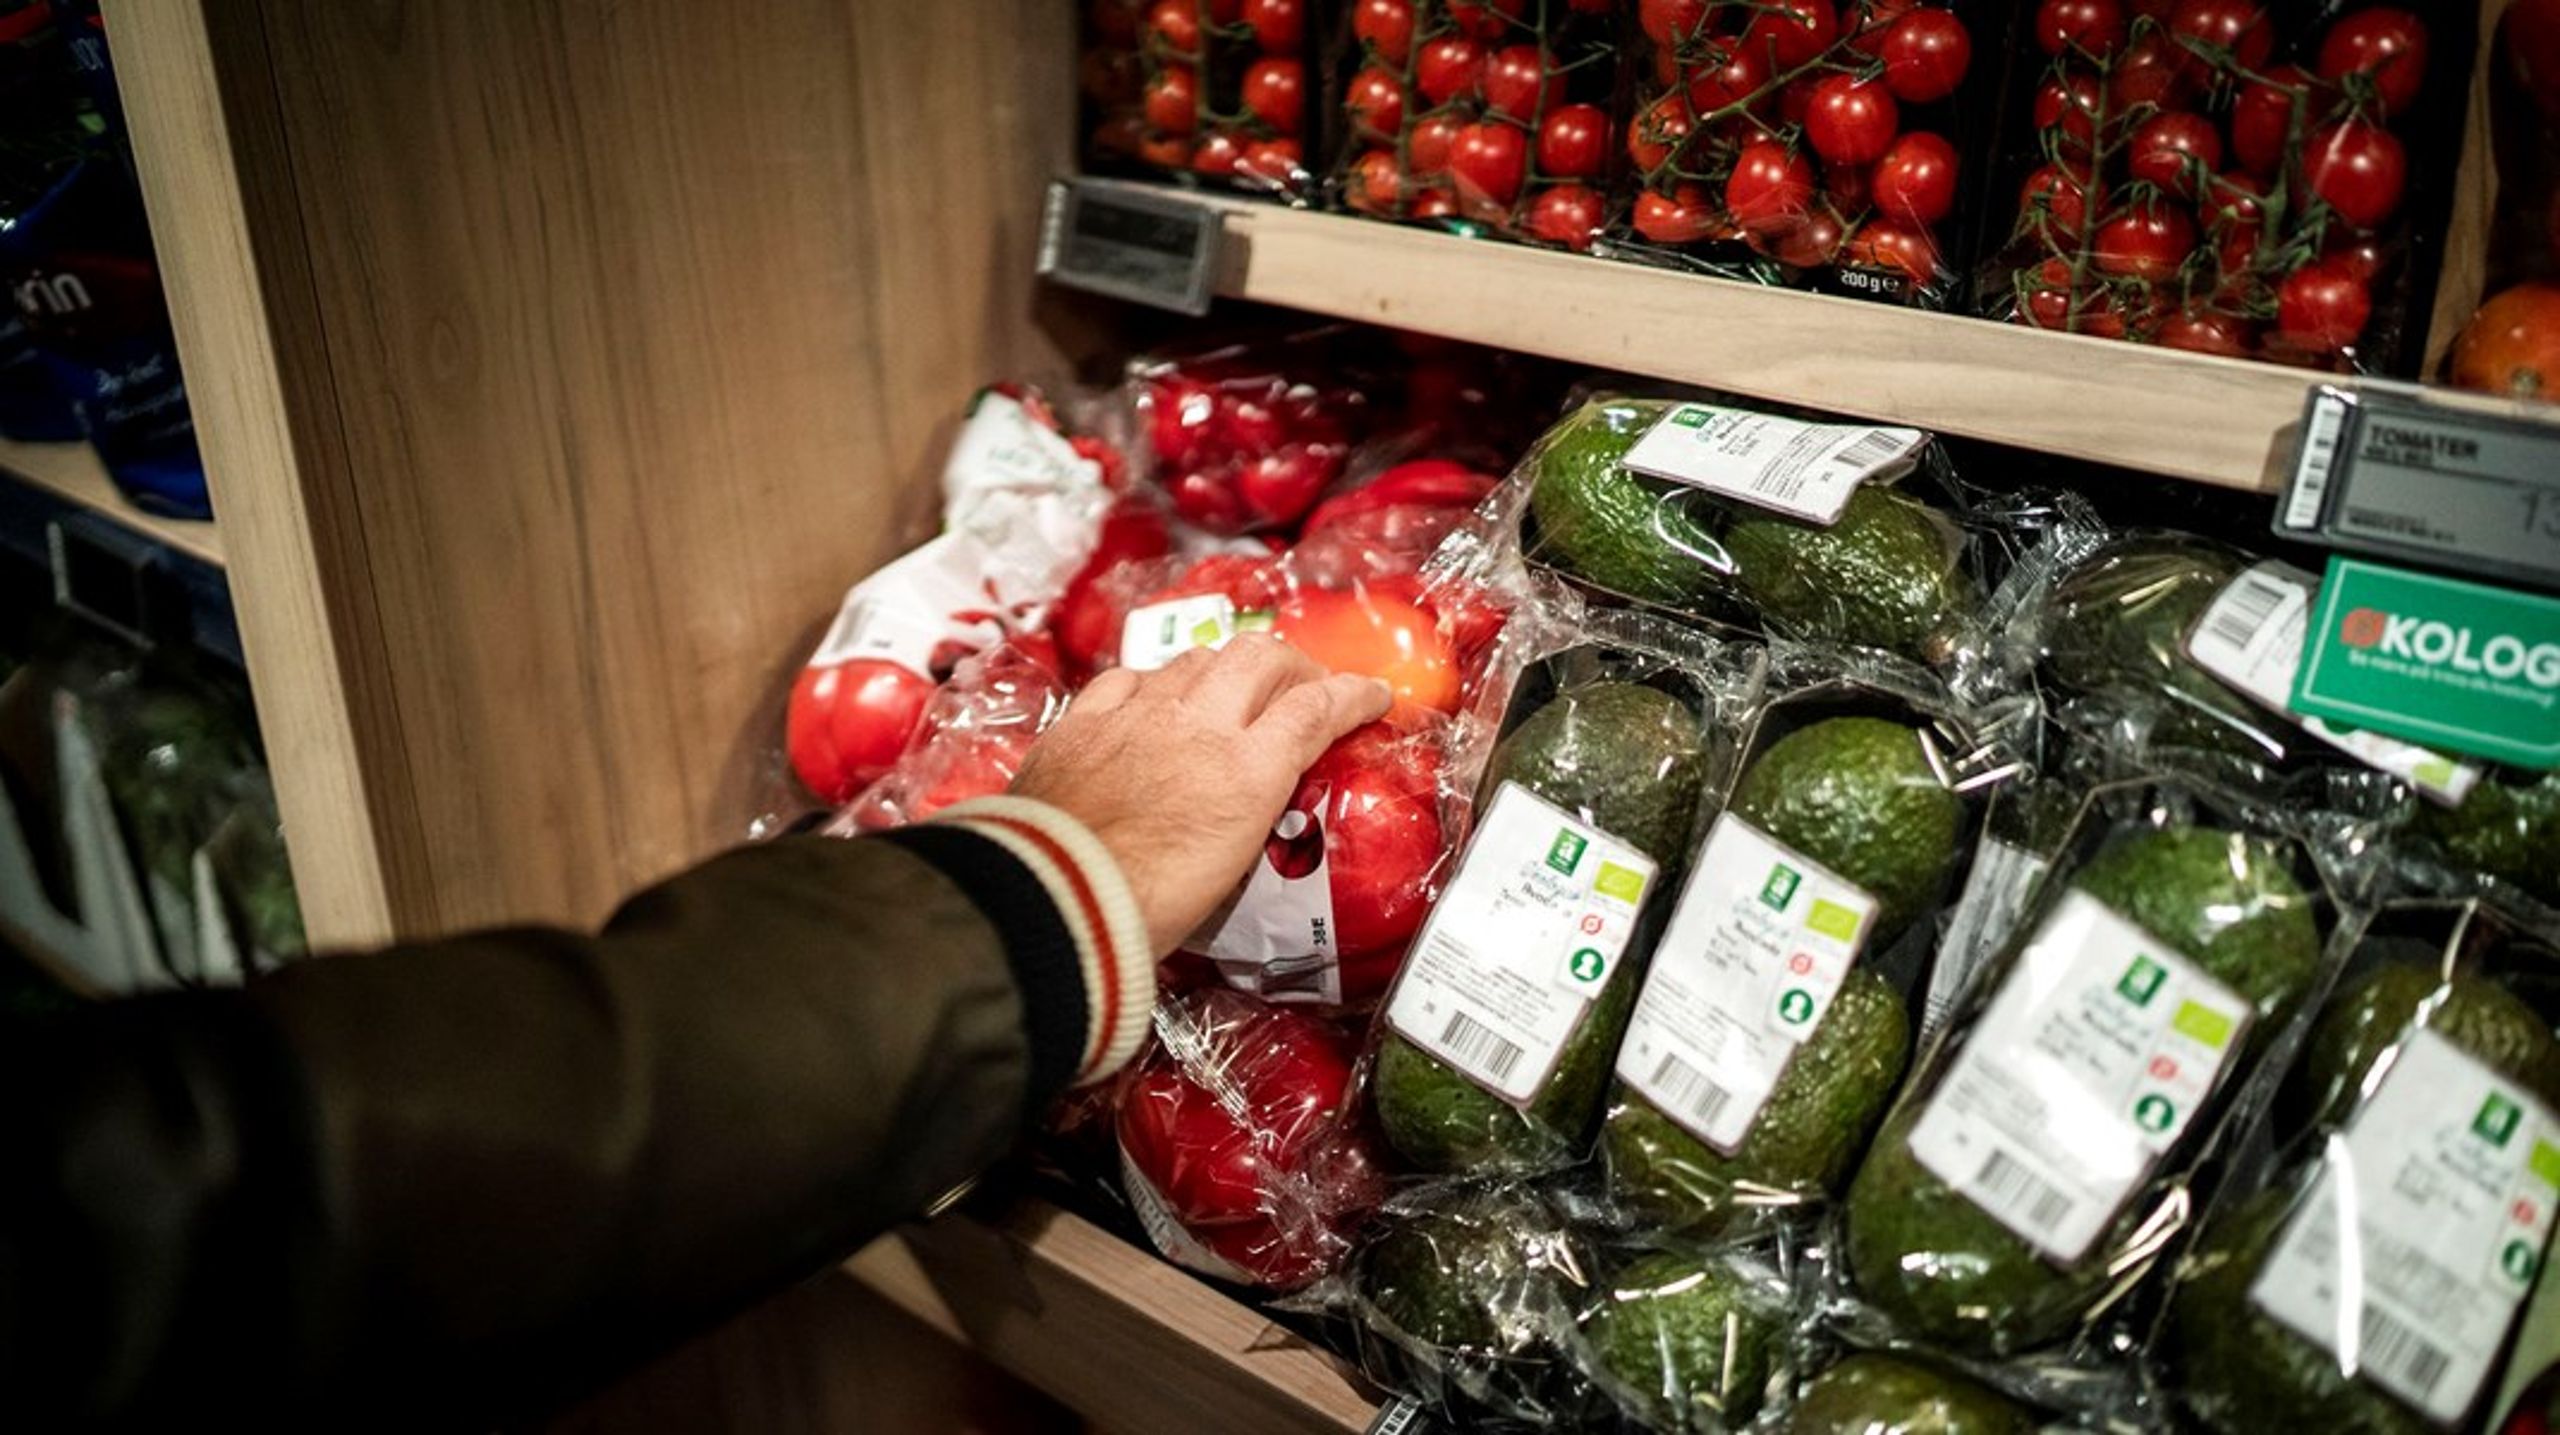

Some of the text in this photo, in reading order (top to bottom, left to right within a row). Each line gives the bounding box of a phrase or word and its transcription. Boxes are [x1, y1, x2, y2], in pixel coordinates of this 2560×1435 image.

[1840, 268, 1868, 289] 200
[1869, 276, 1881, 293] g
[2371, 425, 2480, 463] TOMATER
